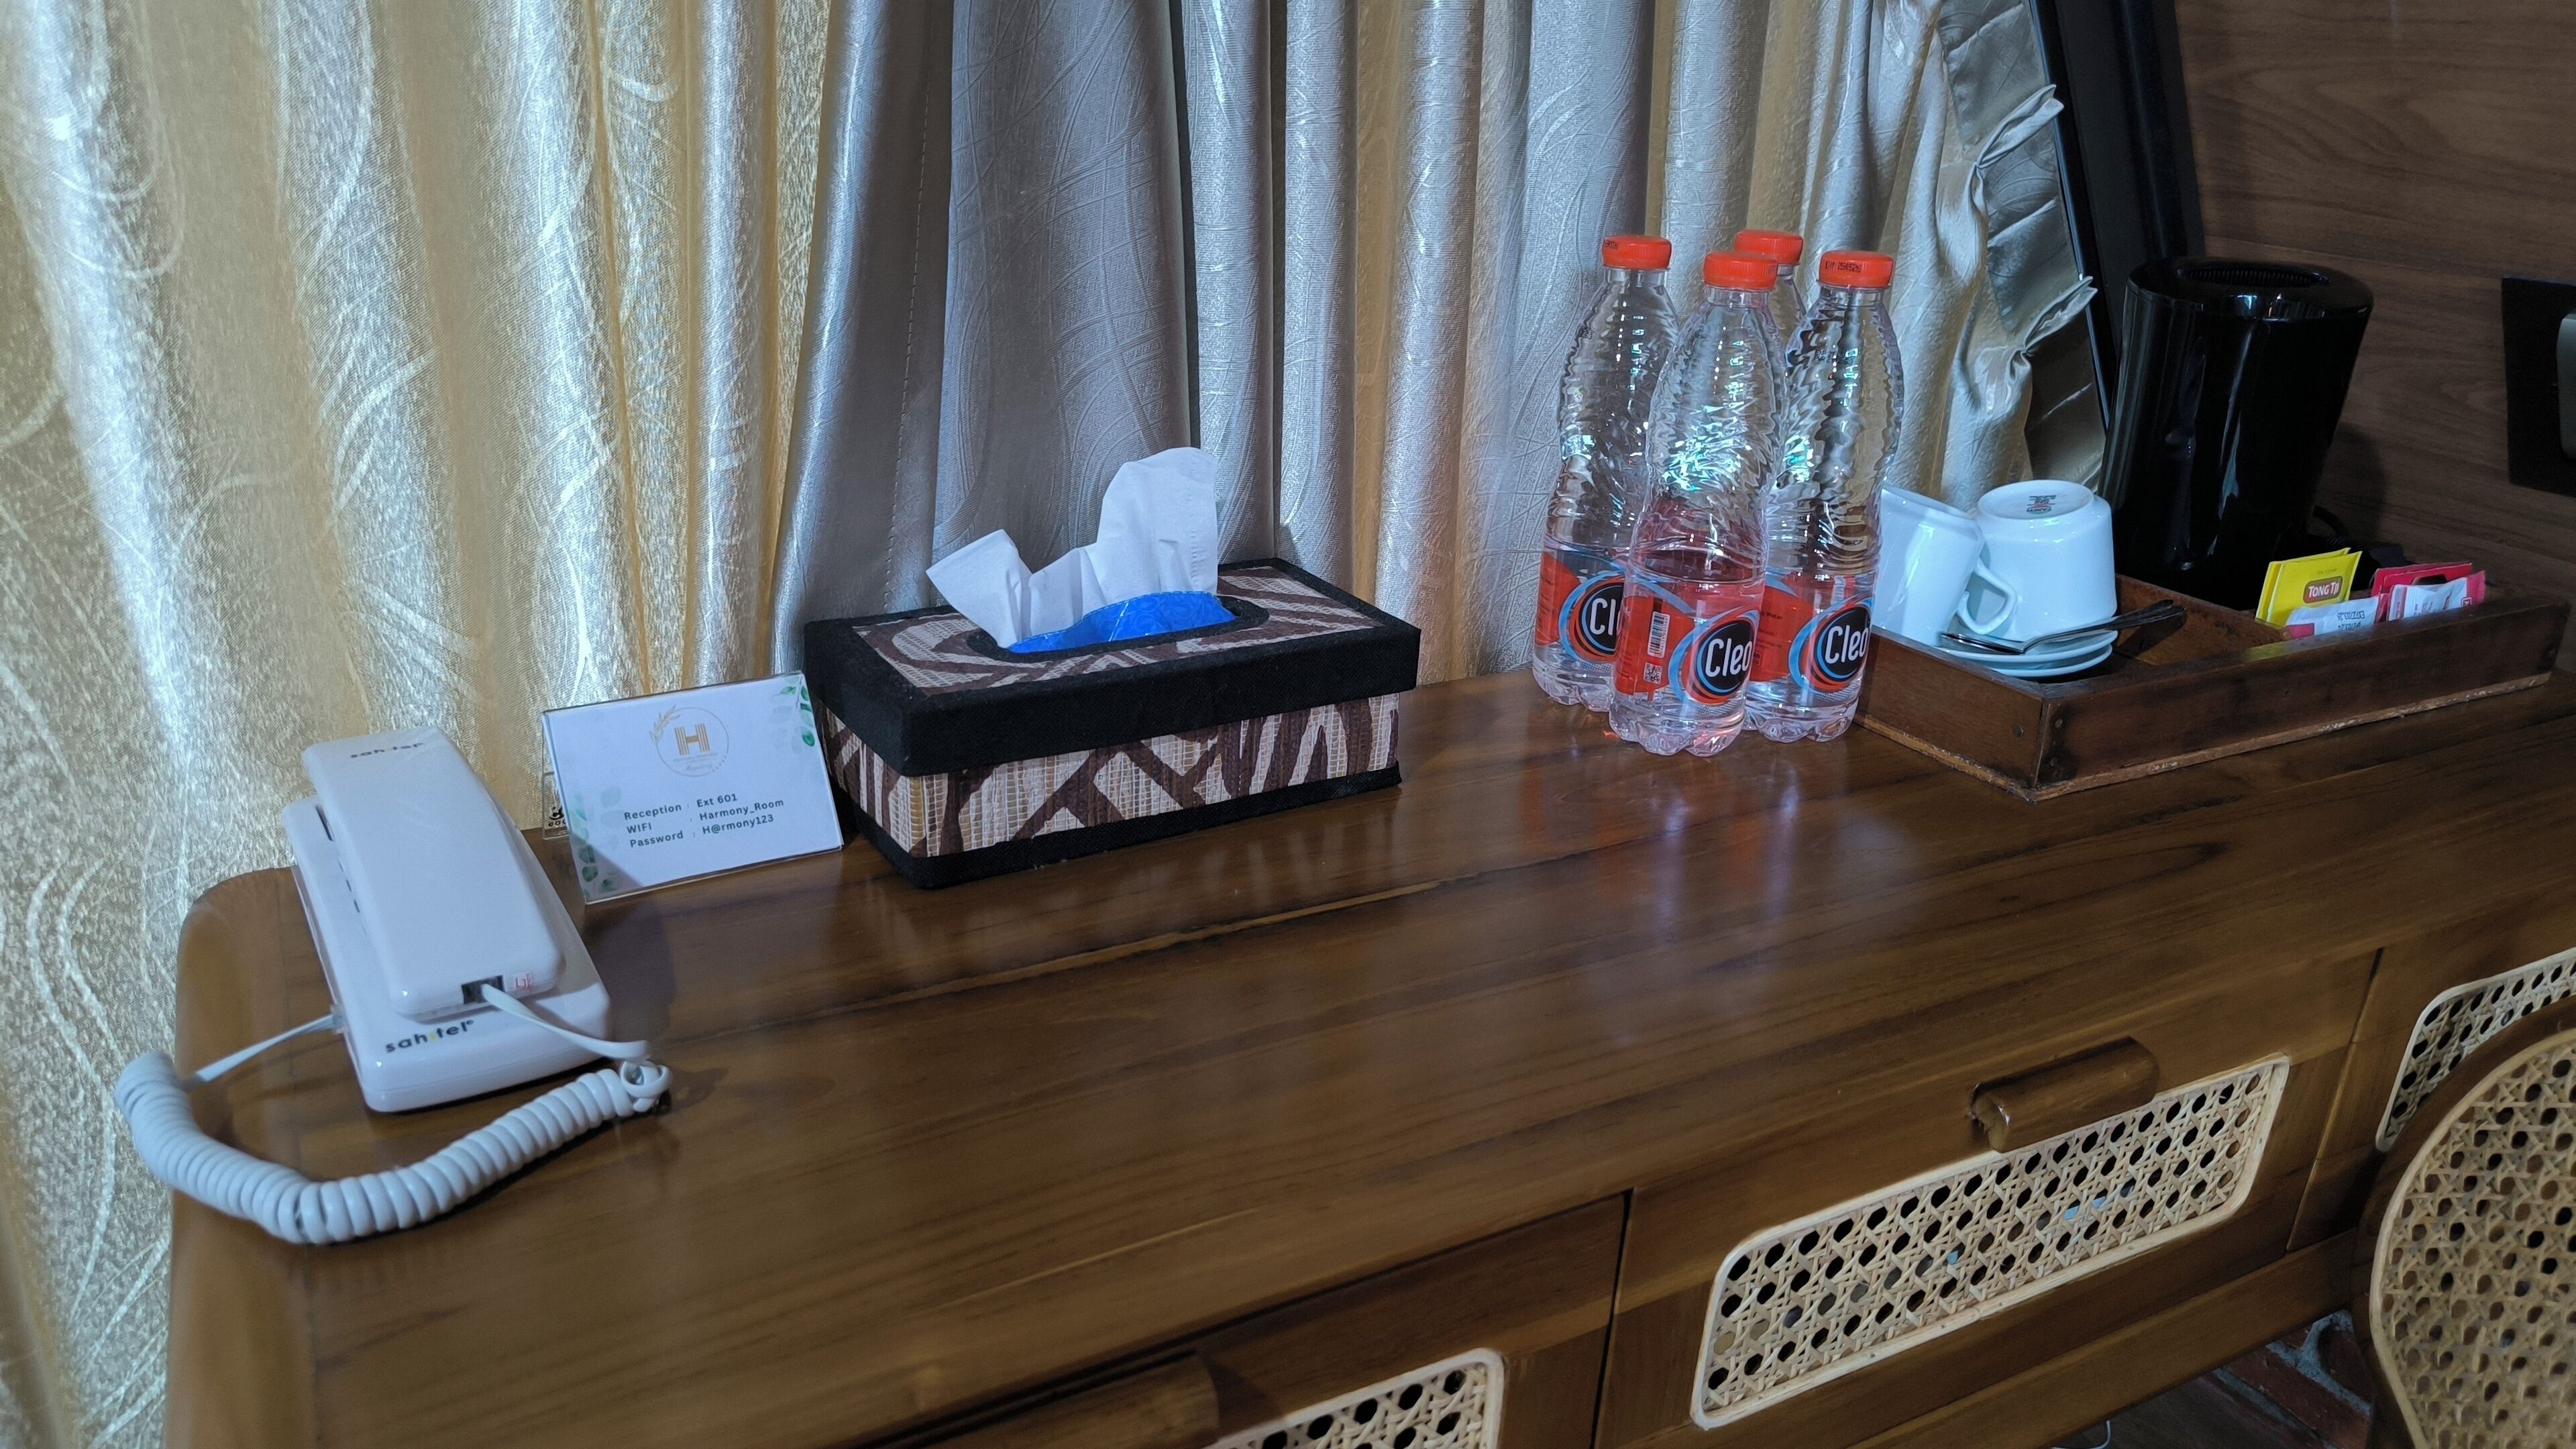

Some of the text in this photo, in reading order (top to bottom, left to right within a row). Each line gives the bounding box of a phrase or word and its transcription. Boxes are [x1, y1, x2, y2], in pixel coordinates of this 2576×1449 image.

[2308, 584, 2330, 598] TONG
[1590, 597, 1617, 636] Cl
[1705, 637, 1753, 678] Cleo
[1825, 625, 1870, 664] Cleo
[624, 793, 738, 820] Reception Ext 601
[627, 800, 784, 834] WIFI Harmony_Room
[630, 814, 774, 848] Password H@rmony123
